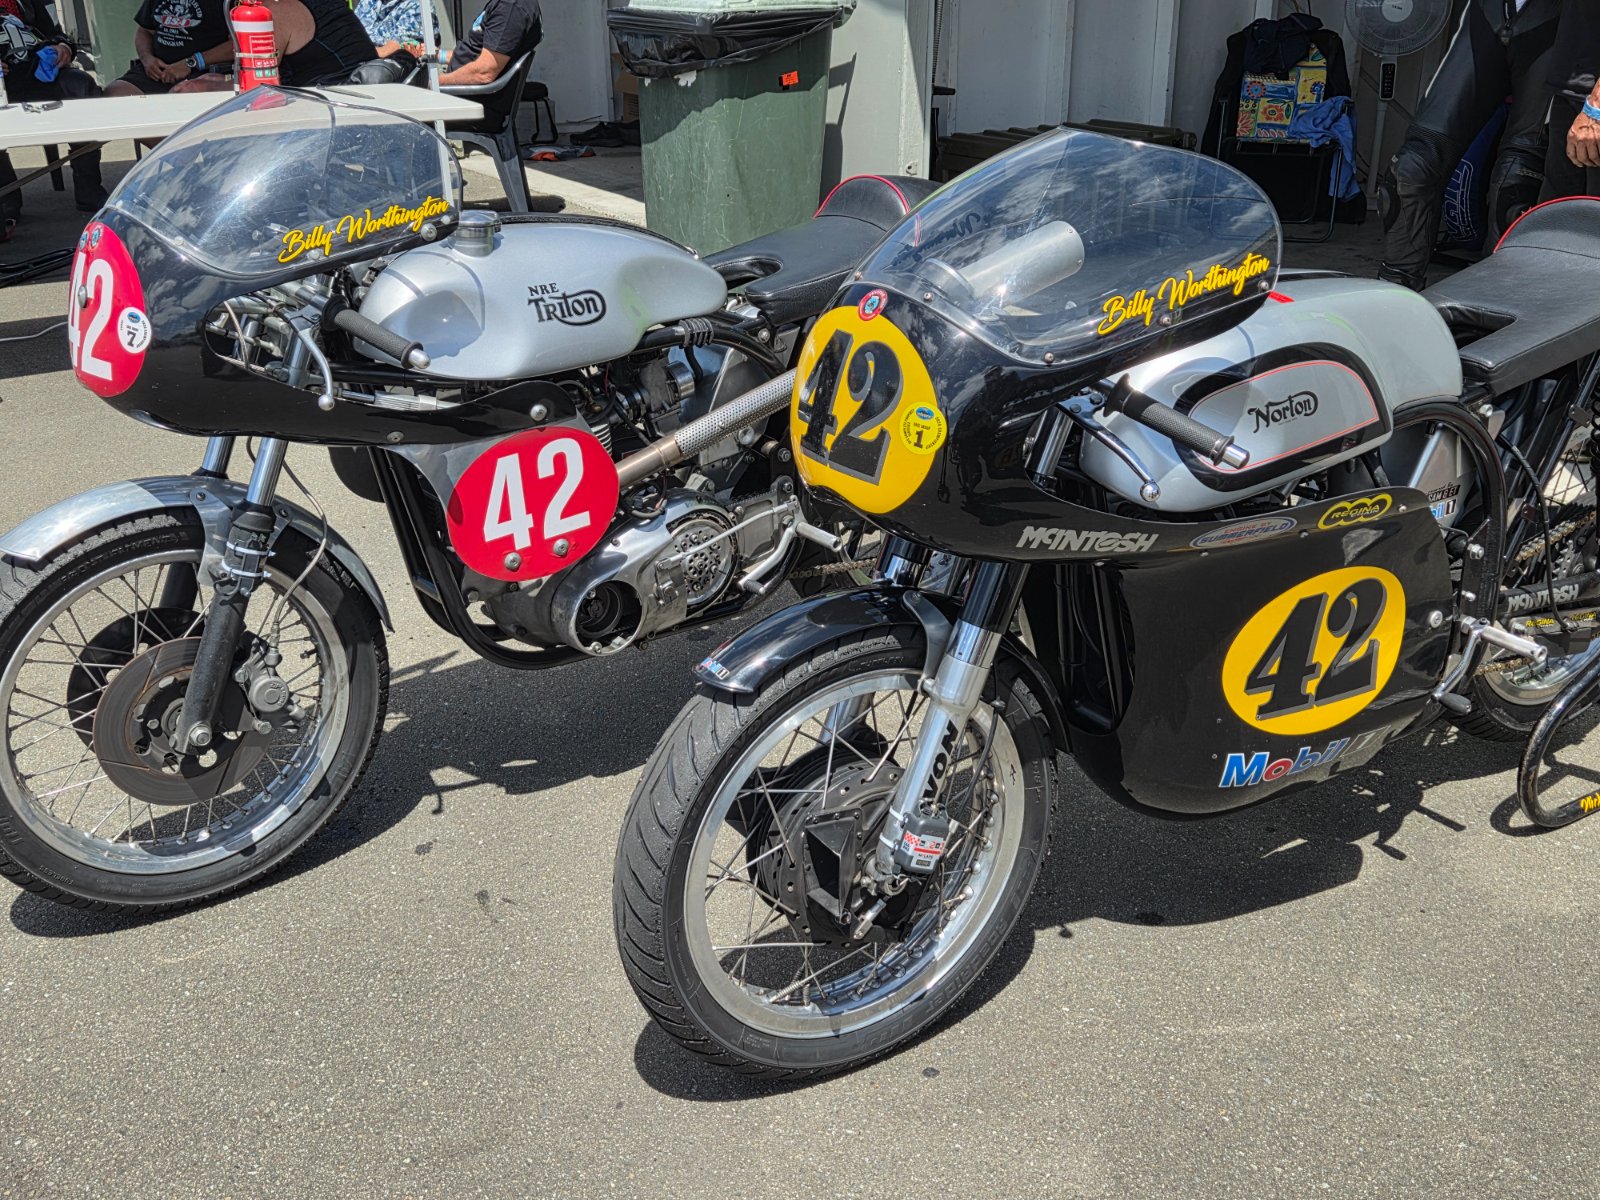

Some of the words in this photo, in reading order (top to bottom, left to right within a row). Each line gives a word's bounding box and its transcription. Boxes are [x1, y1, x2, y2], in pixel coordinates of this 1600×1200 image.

[278, 225, 333, 263] Billy
[336, 195, 449, 244] Worthington
[68, 252, 114, 381] 42
[528, 282, 559, 297] NRE
[1097, 289, 1155, 335] Billy
[1158, 252, 1271, 310] Worthington
[798, 328, 905, 486] 42
[913, 430, 924, 448] 1
[1247, 390, 1318, 433] Norton
[483, 437, 591, 550] 42
[1331, 504, 1380, 519] REGINA
[1200, 522, 1288, 544] SUMMERFIELD
[1244, 577, 1388, 721] 42
[922, 719, 959, 798] VON
[1218, 736, 1352, 788] Mobil
